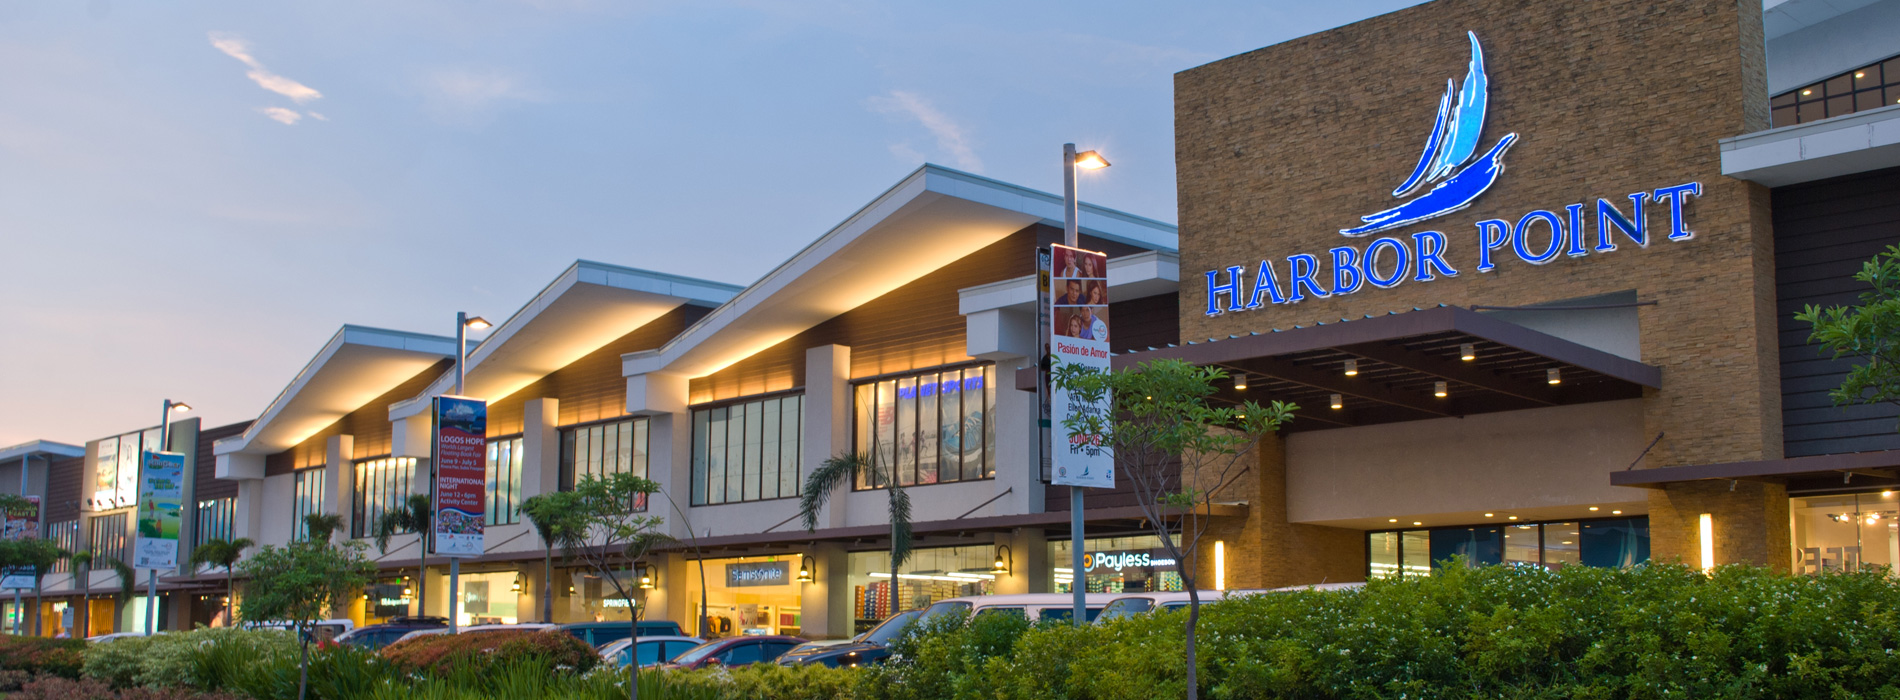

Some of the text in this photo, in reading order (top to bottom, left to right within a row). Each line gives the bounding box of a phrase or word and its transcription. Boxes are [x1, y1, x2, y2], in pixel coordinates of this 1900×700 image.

[1205, 182, 1703, 316] HARBOR POINT
[1058, 342, 1108, 359] Pasión de Amor
[899, 375, 983, 399] PLANET SPORTS
[441, 435, 485, 446] LOGOS HOPE
[1069, 434, 1100, 446] JUNE 26
[1070, 444, 1079, 455] Fri
[1086, 446, 1100, 458] 5pm
[440, 477, 485, 485] INTERNATIONAL
[1095, 552, 1150, 572] Payless
[732, 568, 781, 581] Samsonite
[603, 598, 636, 608] SPRINGFIED
